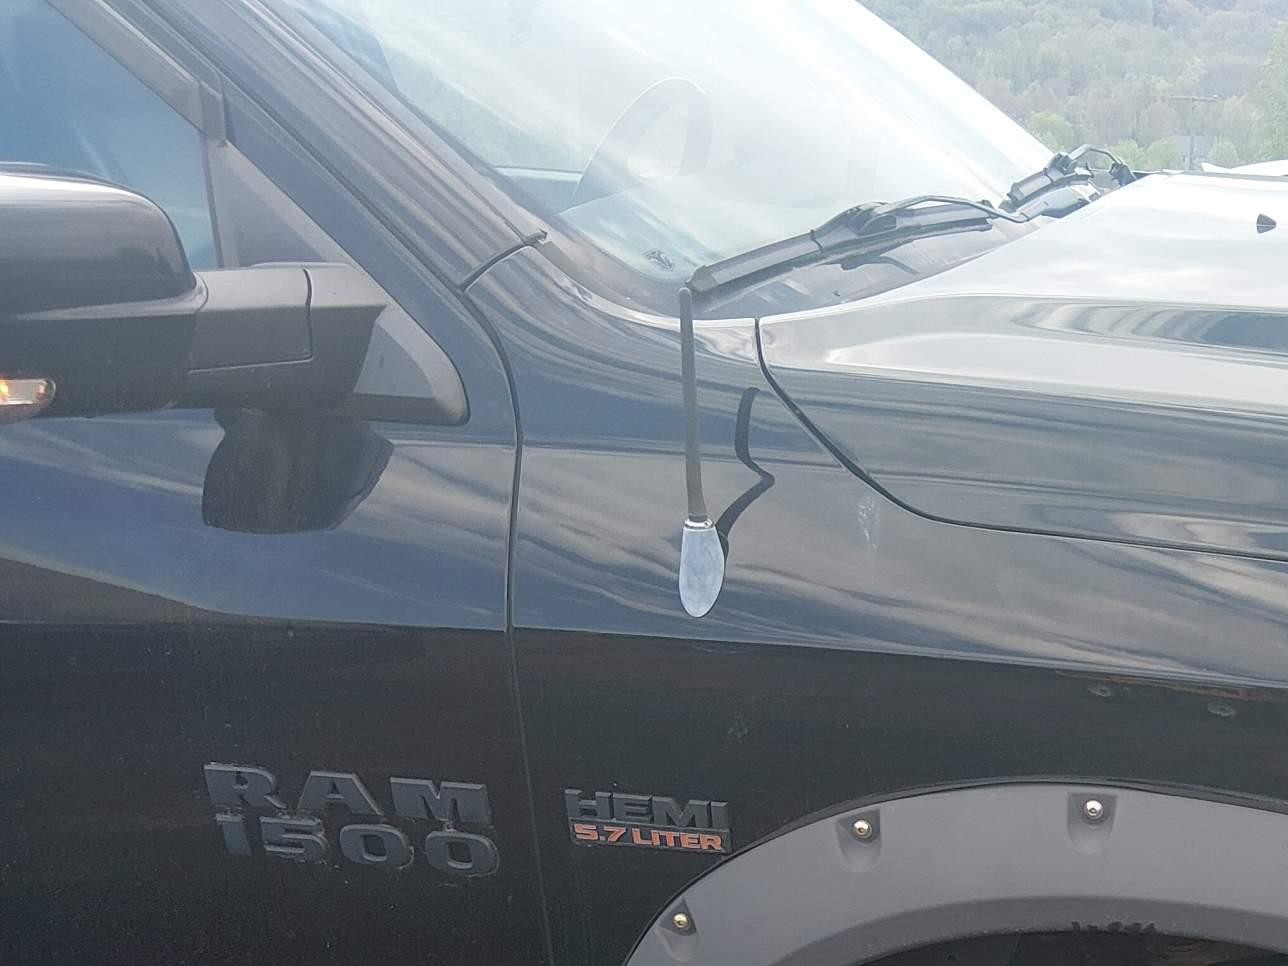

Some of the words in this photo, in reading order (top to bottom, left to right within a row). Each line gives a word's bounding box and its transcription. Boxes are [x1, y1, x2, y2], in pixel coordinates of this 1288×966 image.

[203, 762, 490, 824] RAM
[564, 788, 729, 829] HEMI
[215, 813, 498, 875] 1500
[574, 823, 627, 842] 5.7
[631, 828, 724, 851] LITER
